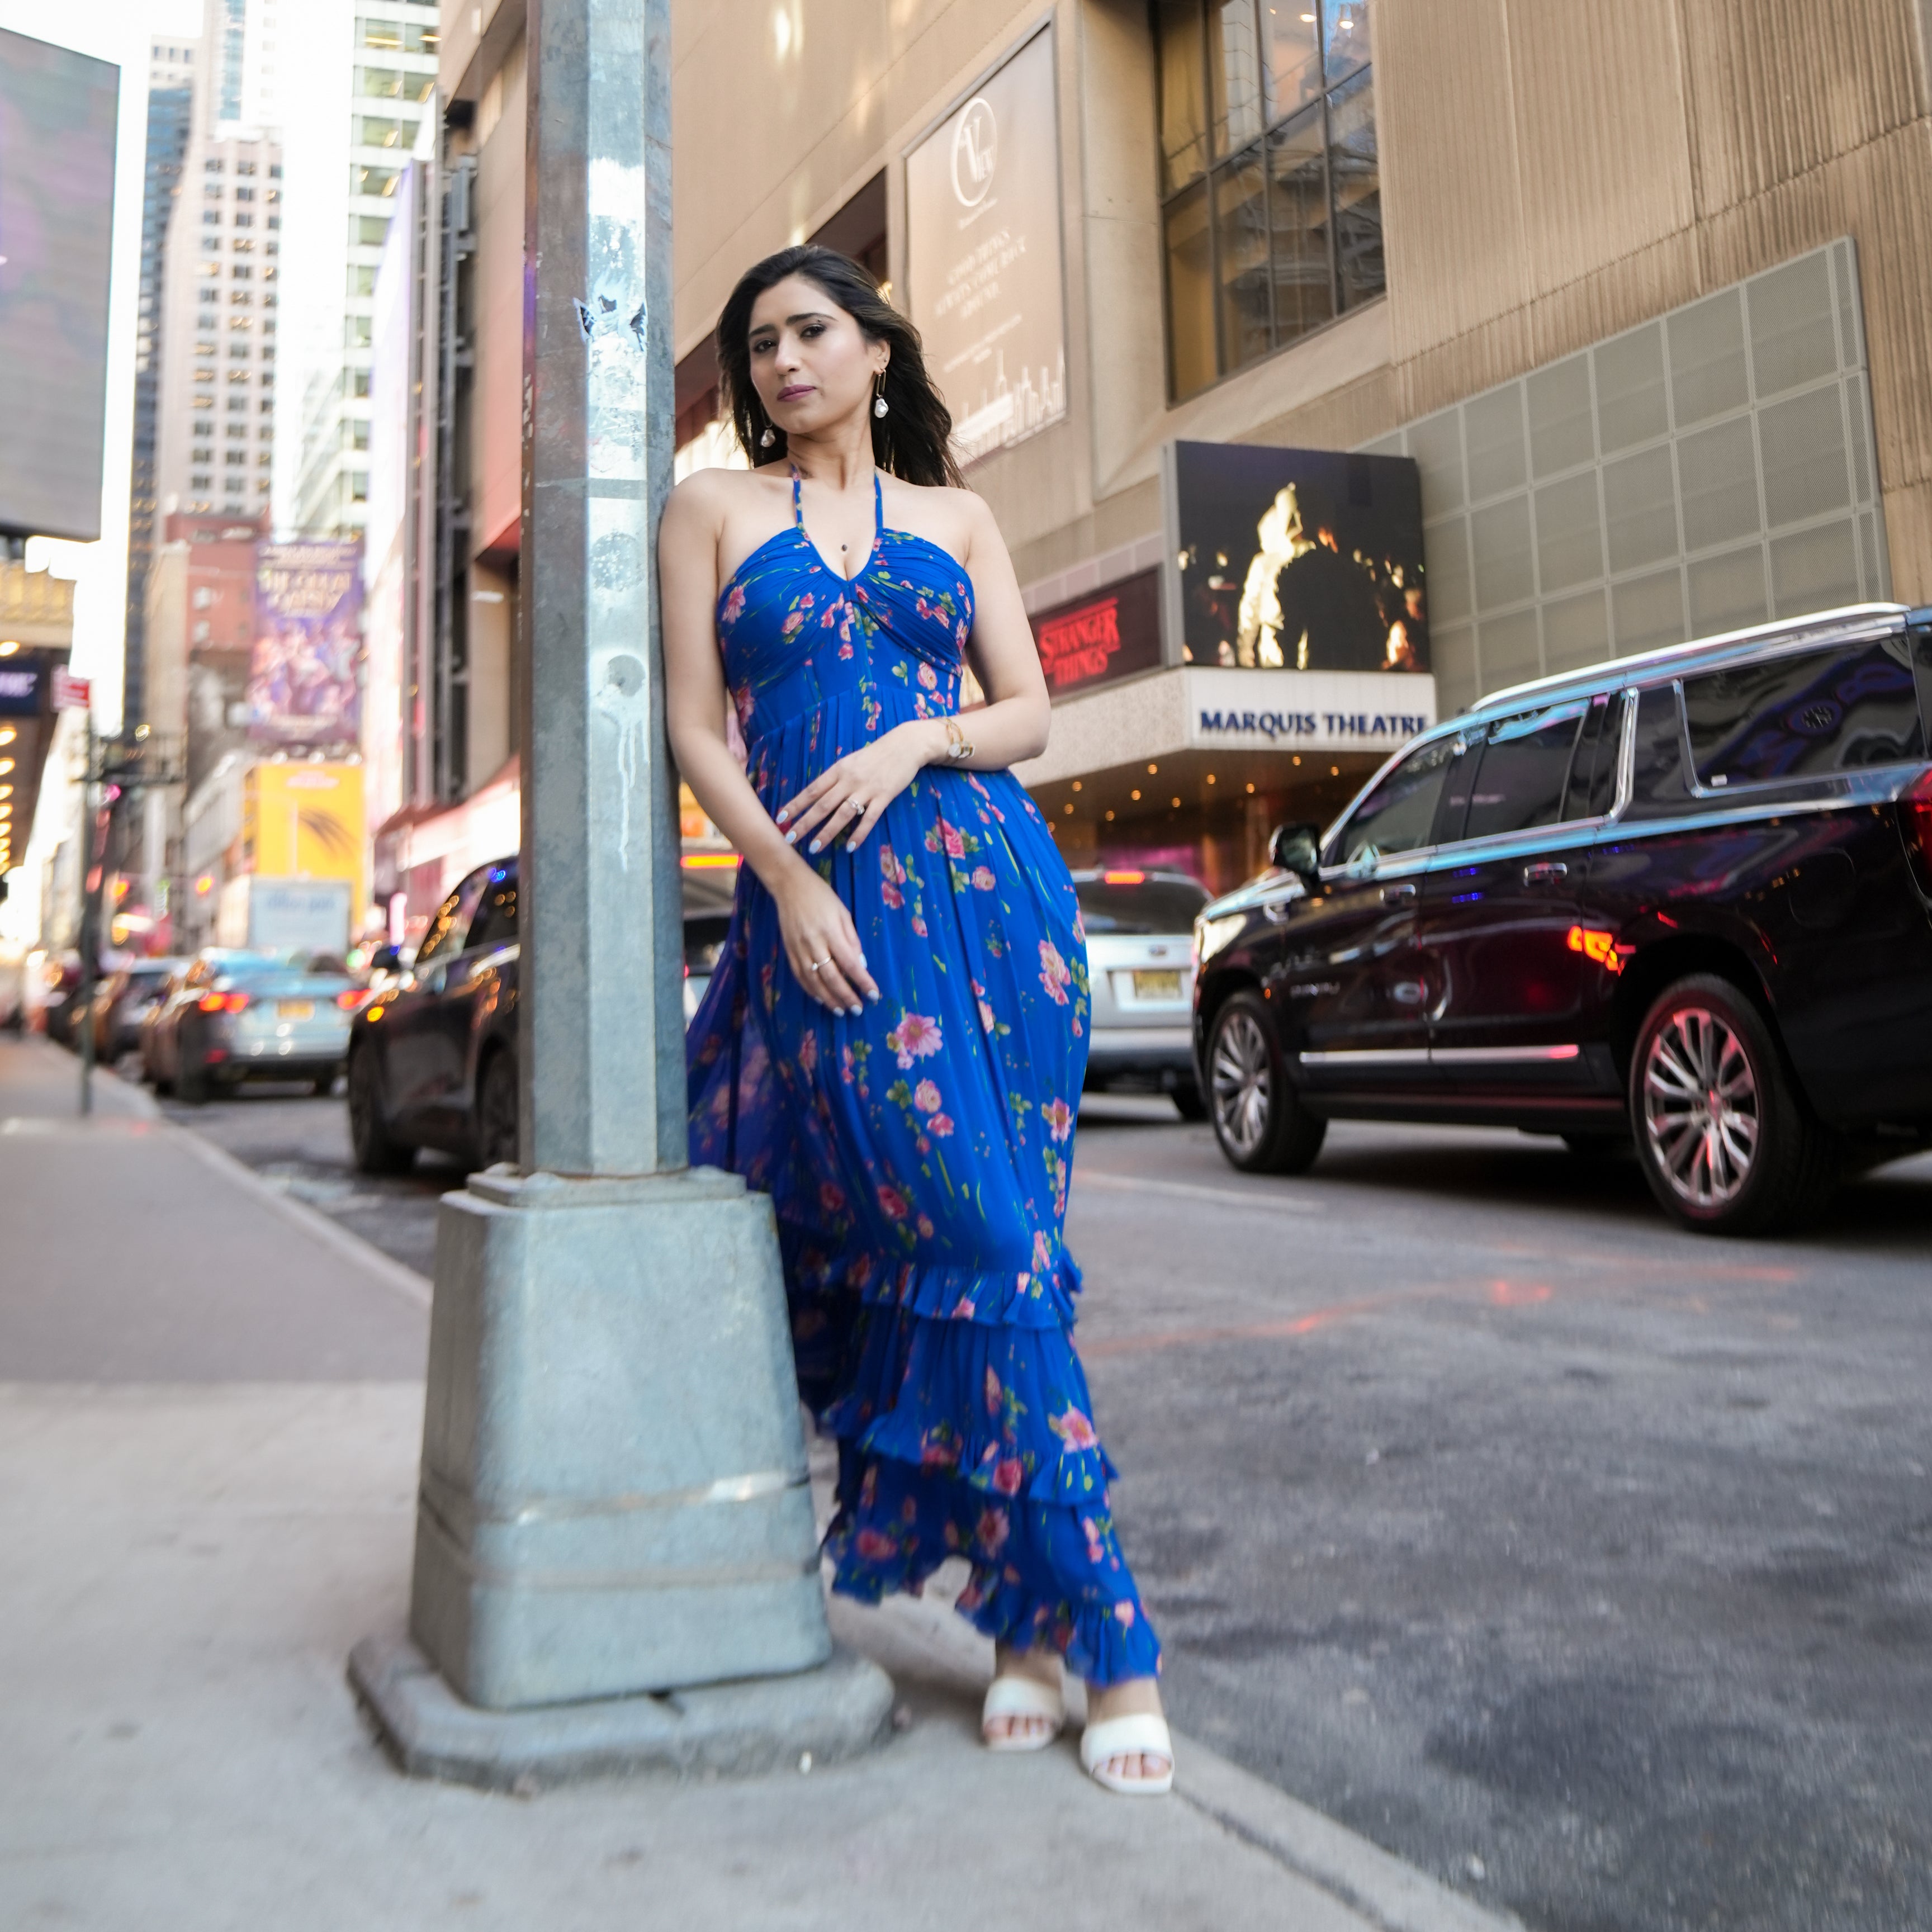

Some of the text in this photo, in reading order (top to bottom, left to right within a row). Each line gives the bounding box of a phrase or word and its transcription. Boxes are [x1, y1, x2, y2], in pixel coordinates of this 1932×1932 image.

[1039, 606, 1120, 664] STRANGER
[1054, 647, 1108, 688] THINGS
[1200, 711, 1427, 741] MARQUIS THEATRE
